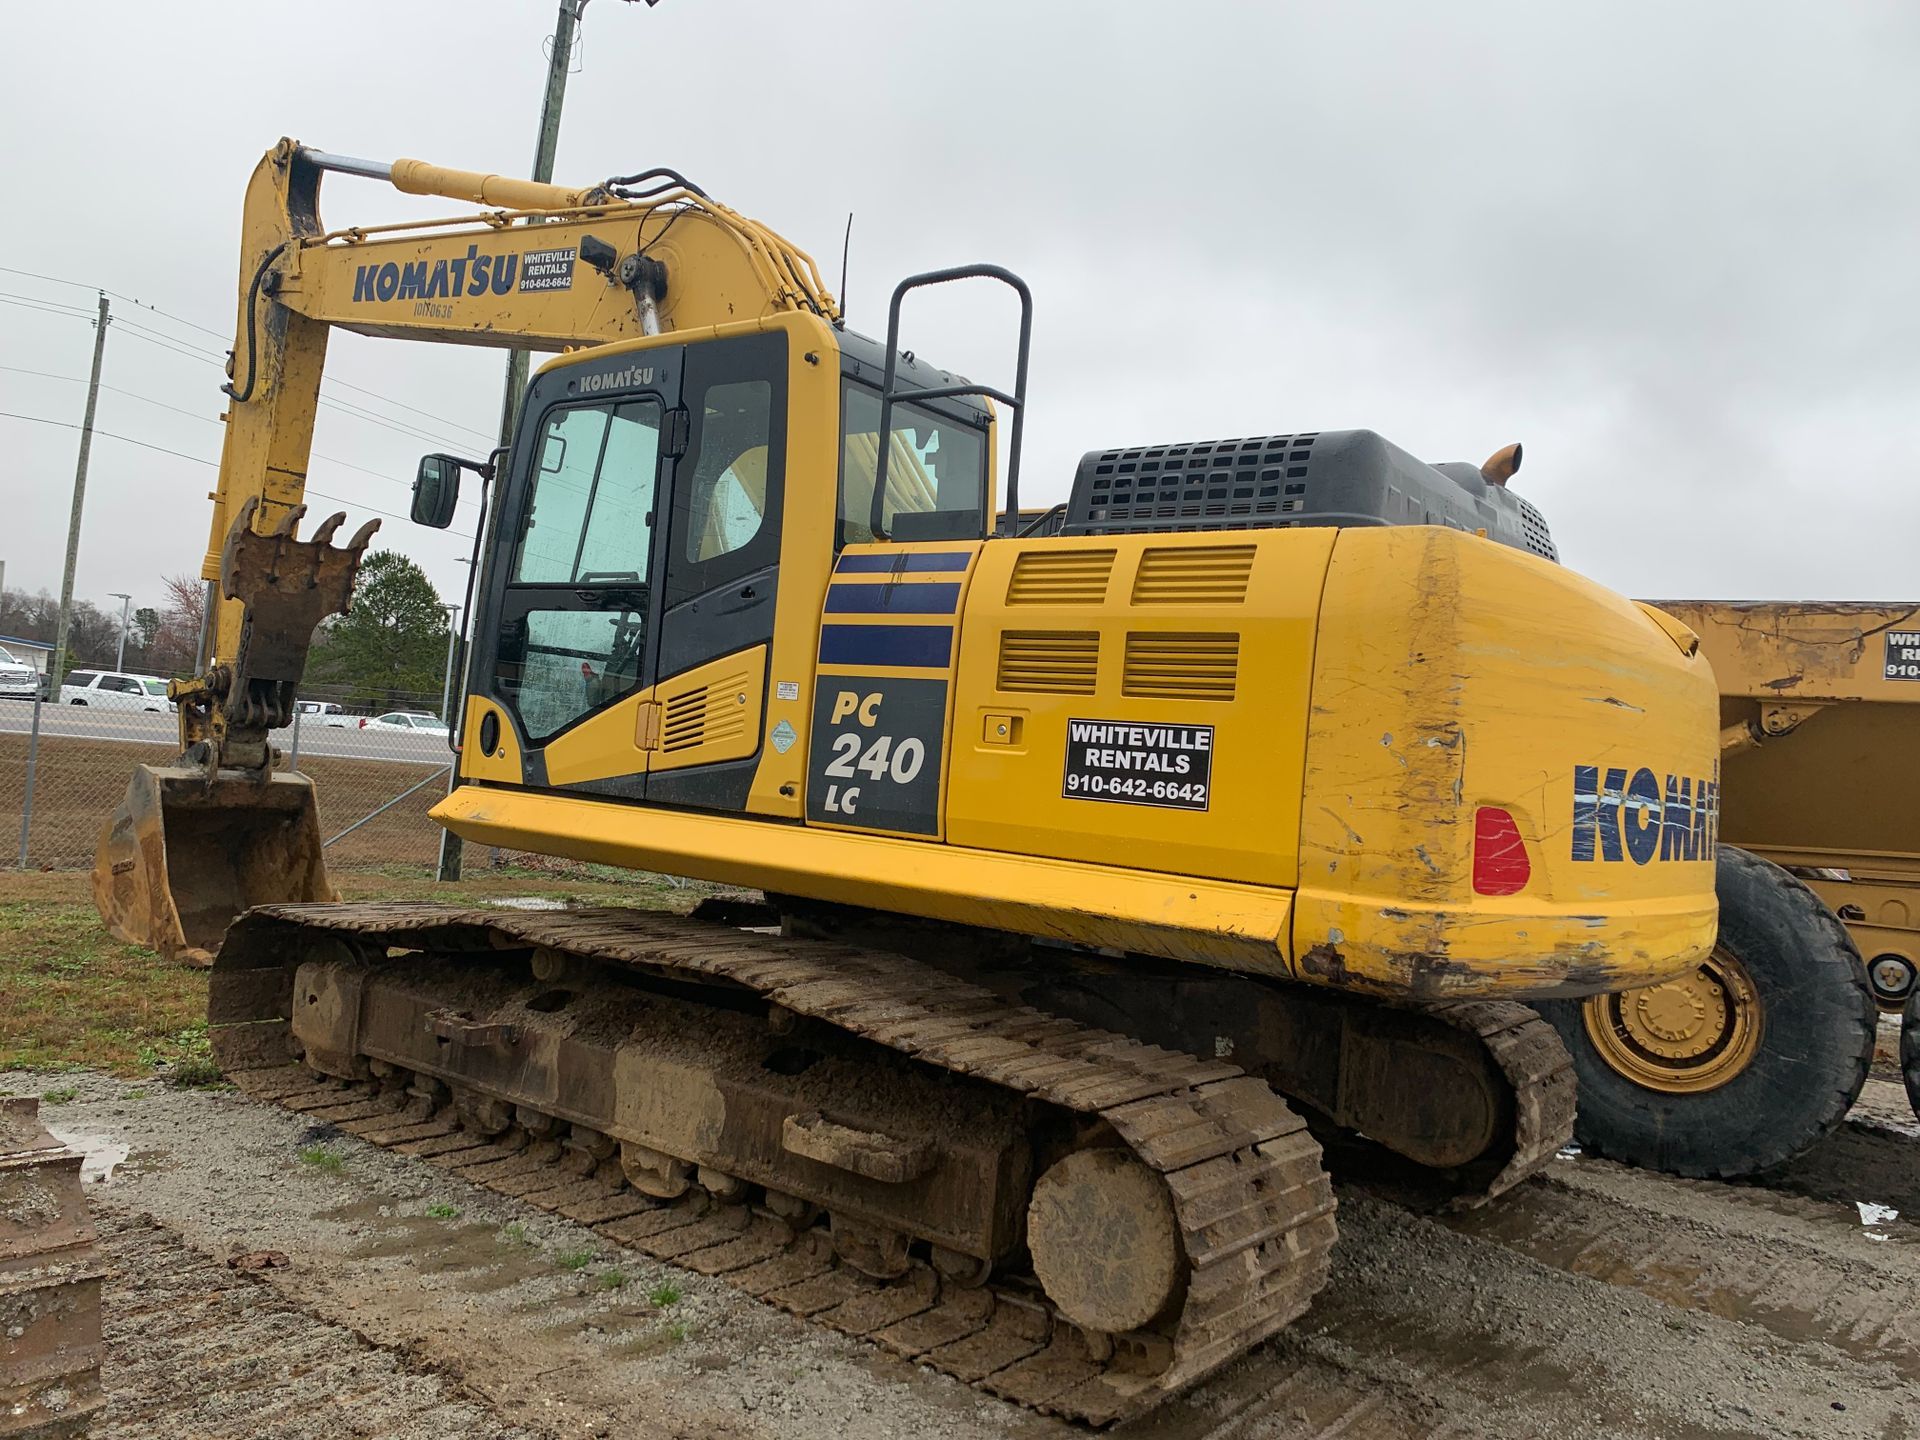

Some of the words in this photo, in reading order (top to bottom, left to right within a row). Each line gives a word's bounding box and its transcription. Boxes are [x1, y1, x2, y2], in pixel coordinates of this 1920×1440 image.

[524, 250, 576, 264] WHITEVILLE
[528, 263, 568, 276] RENTALS
[353, 245, 518, 302] KOMATSU
[520, 276, 571, 289] 910-642-6642
[580, 365, 654, 393] KOMATSU
[830, 691, 883, 727] PC
[1071, 724, 1210, 751] WHITEVILLE
[824, 732, 925, 784] 240
[1085, 748, 1191, 774] RENTALS
[824, 784, 861, 814] LC
[1067, 773, 1206, 802] 910-642-6642
